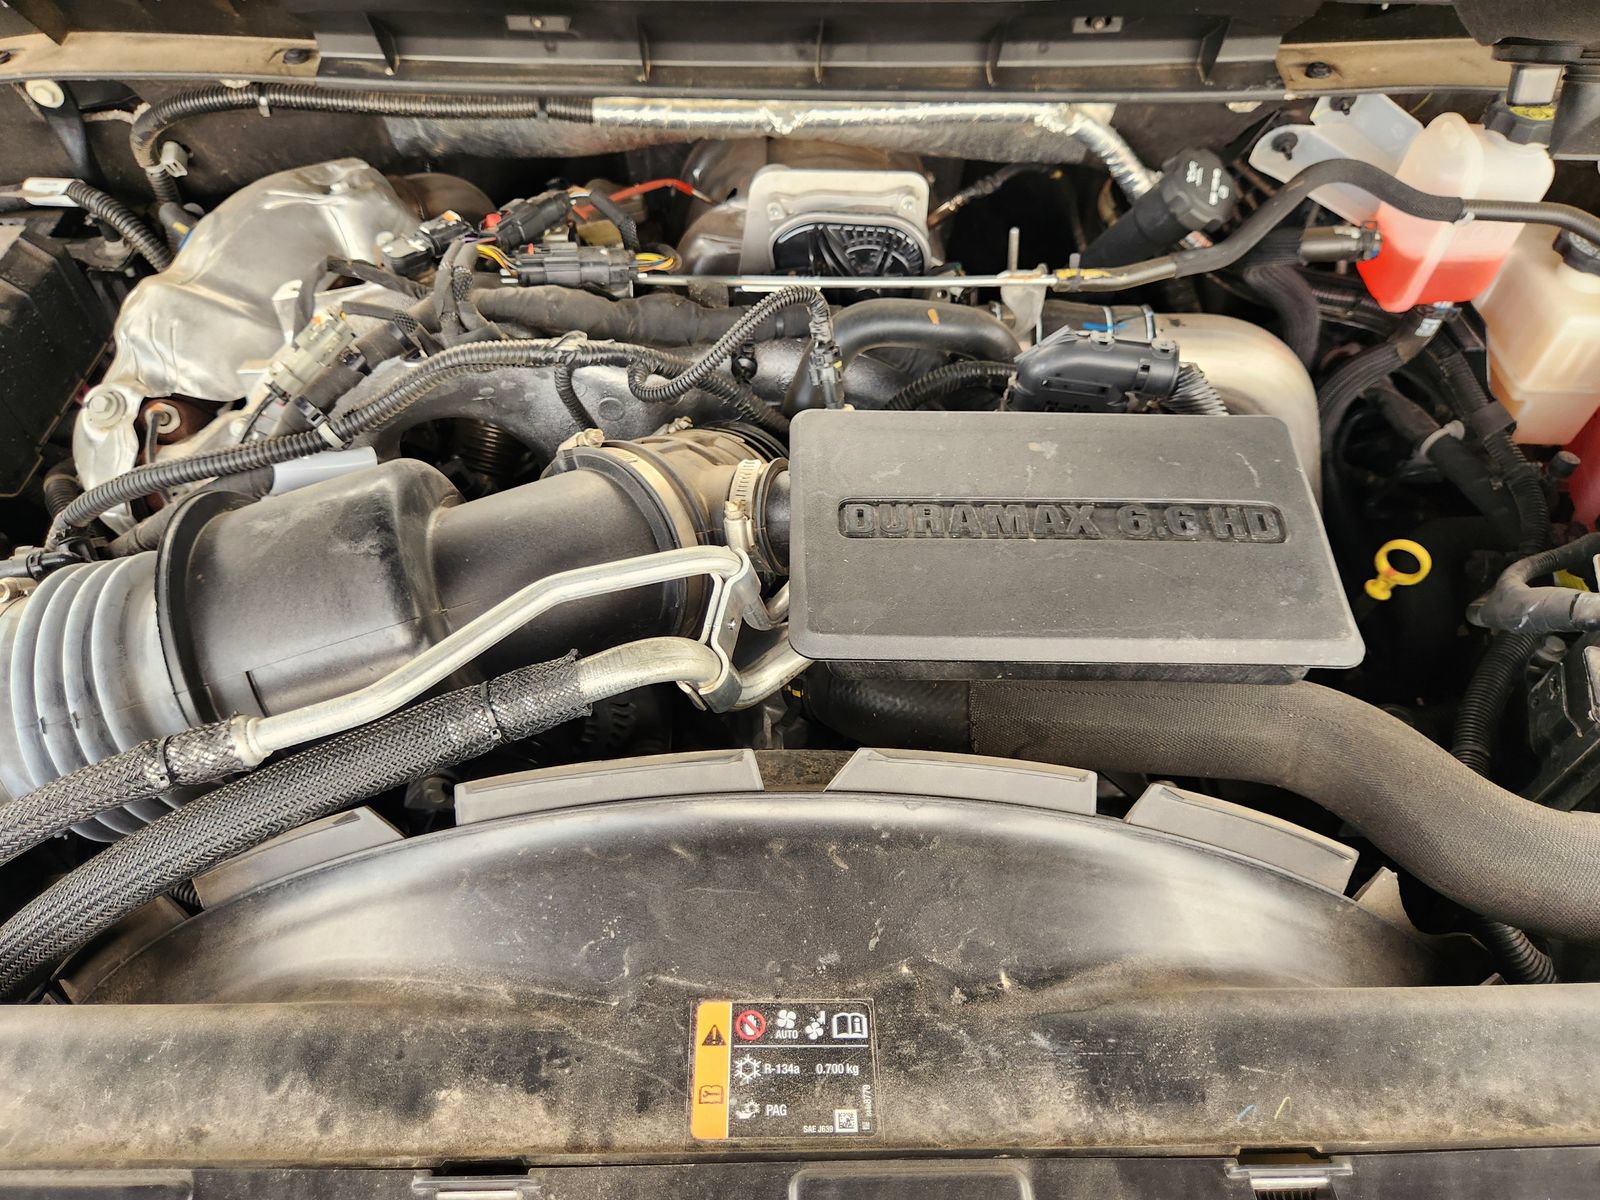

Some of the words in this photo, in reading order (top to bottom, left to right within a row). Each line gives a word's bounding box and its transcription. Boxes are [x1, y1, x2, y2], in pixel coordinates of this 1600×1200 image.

[845, 503, 1101, 536] DURAMAX
[1116, 504, 1200, 537] 6.6
[1207, 505, 1281, 540] HD
[775, 1029, 799, 1039] AUTO
[764, 1063, 800, 1074] R-134a
[816, 1063, 844, 1074] 0.700
[846, 1063, 859, 1076] kg
[766, 1104, 787, 1116] PAG
[803, 1125, 816, 1133] SAE
